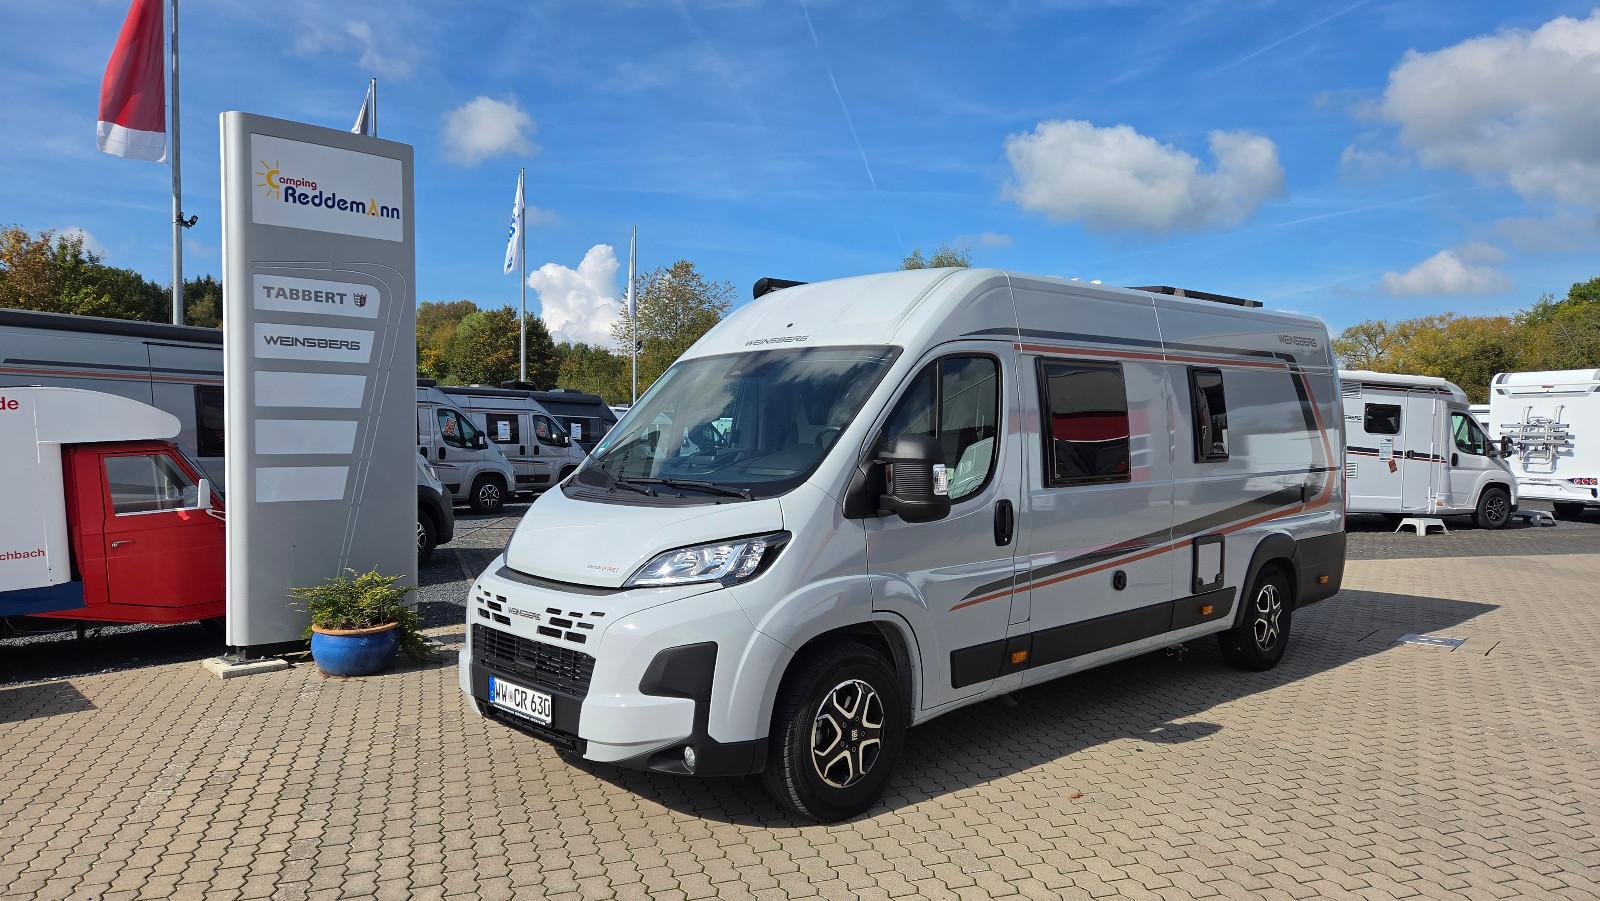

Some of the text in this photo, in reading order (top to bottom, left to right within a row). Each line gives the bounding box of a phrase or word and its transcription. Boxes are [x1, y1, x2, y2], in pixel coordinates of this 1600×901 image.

[262, 285, 347, 305] TABBERT
[263, 335, 361, 351] WEINSBERG
[530, 694, 551, 718] 630
